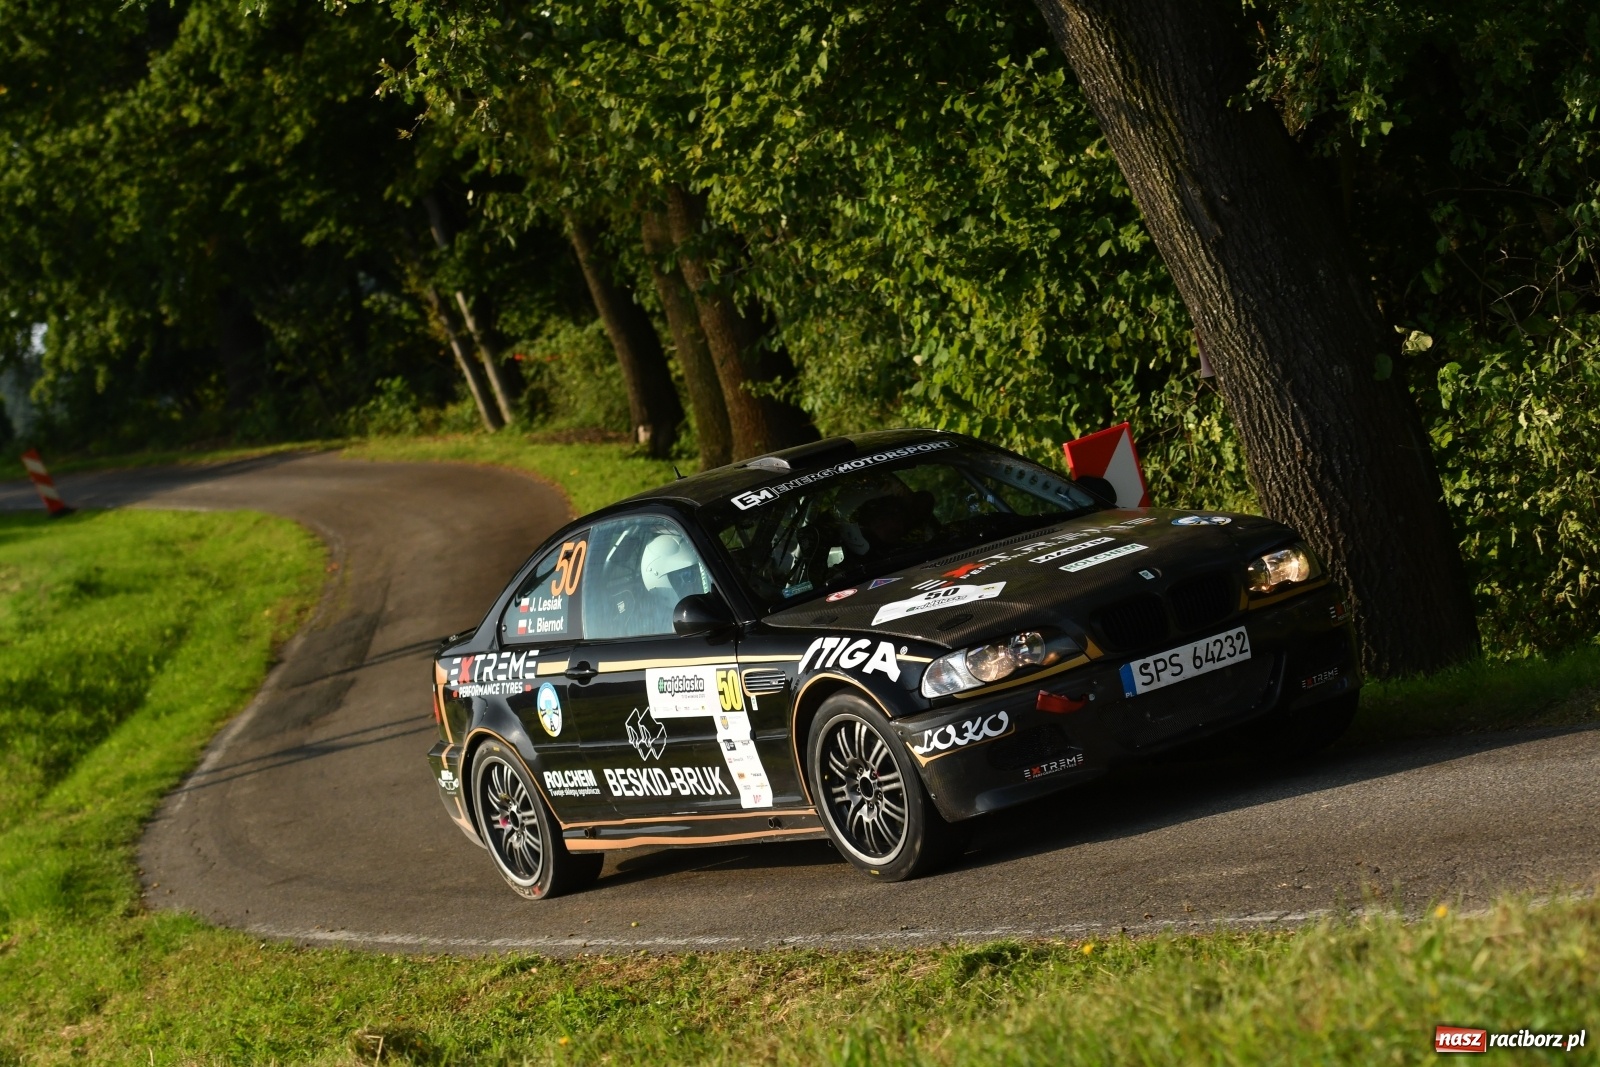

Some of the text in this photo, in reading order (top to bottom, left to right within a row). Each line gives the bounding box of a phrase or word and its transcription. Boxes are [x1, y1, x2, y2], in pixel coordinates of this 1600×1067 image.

[838, 441, 951, 473] MOTORSPORT
[551, 541, 587, 596] 50
[530, 595, 562, 612] J. Lesiak
[924, 587, 961, 600] 50
[537, 616, 564, 632] Biernot
[450, 650, 539, 686] EXTREME
[1139, 631, 1248, 686] SPS 64232
[459, 682, 523, 698] PERFORMANCE TYRES
[658, 675, 704, 697] #rajdslaska
[716, 669, 743, 711] 50
[1023, 753, 1084, 778] EXTREME
[543, 769, 597, 789] ROLCHEM
[603, 766, 731, 796] BESKID-BRUK
